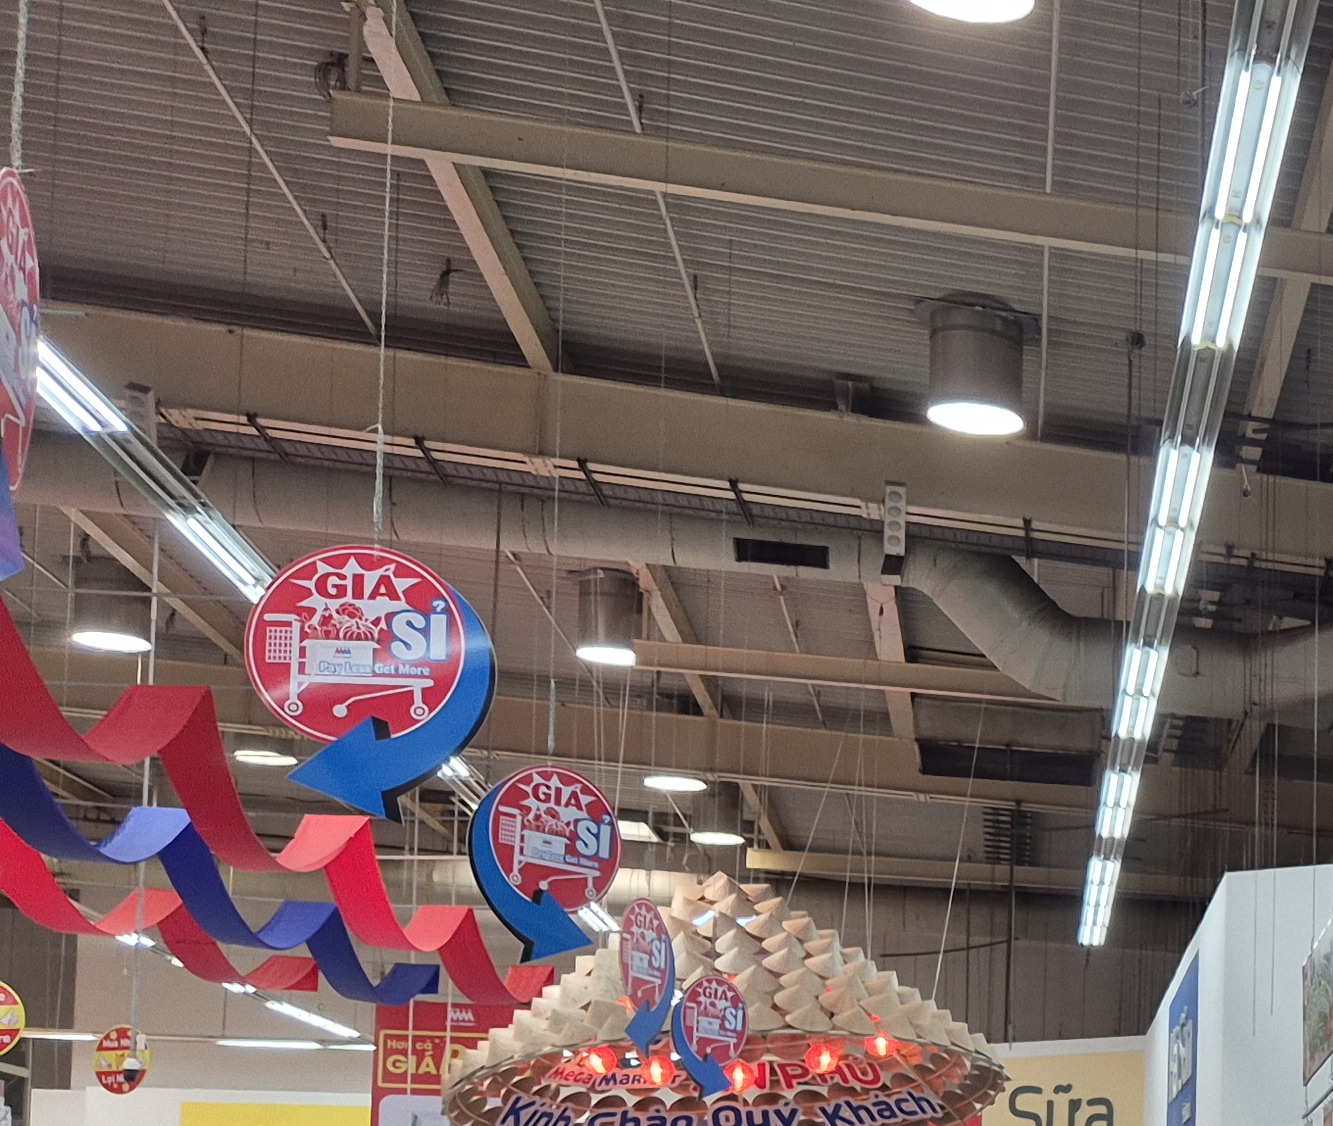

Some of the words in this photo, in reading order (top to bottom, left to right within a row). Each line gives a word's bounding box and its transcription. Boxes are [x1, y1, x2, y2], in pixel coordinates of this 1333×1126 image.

[314, 567, 401, 601] GIÁ
[390, 598, 449, 662] SỈ
[319, 661, 341, 676] Pay
[398, 663, 431, 677] More
[531, 781, 584, 813] GIÁ
[575, 813, 613, 859] SỈ
